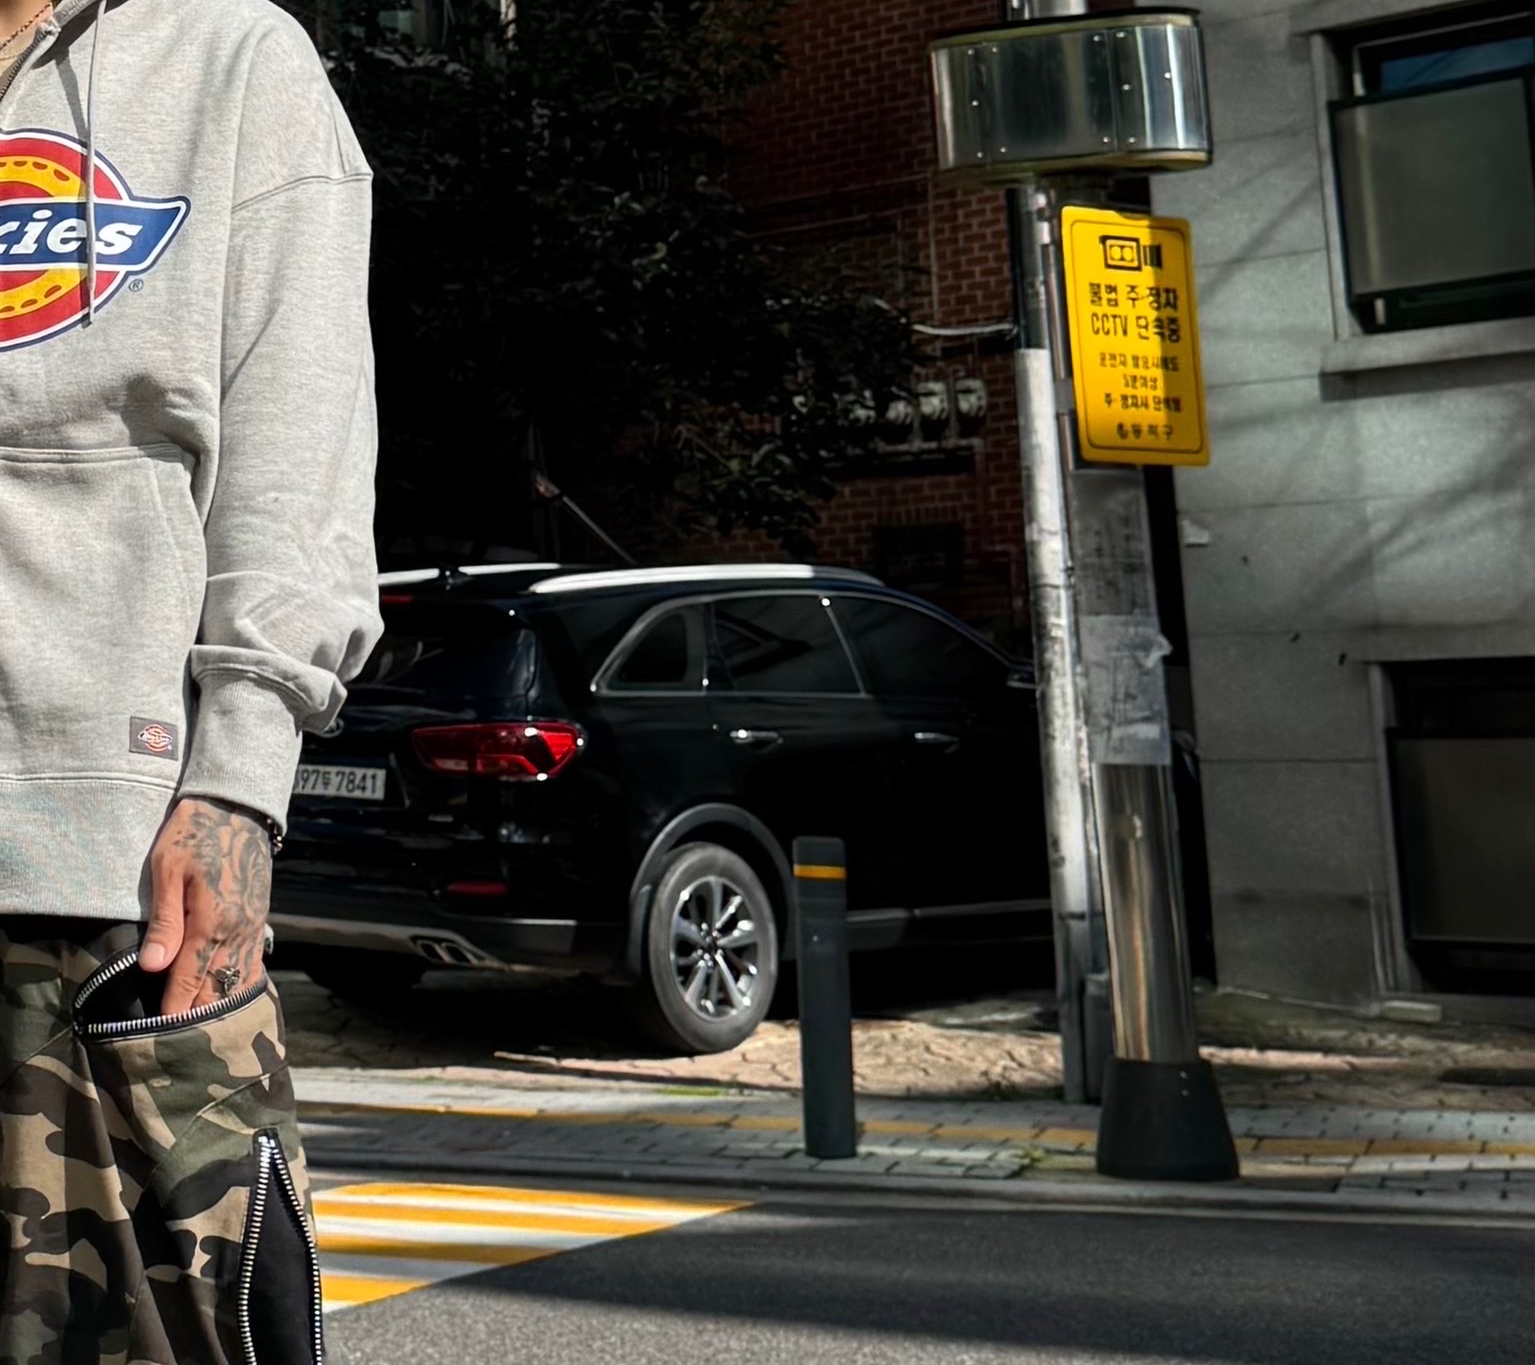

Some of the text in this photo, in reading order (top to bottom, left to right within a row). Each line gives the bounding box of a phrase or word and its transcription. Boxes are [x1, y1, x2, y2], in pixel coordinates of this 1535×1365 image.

[1089, 282, 1119, 308] 불법
[1091, 312, 1181, 344] CCTV 단속중
